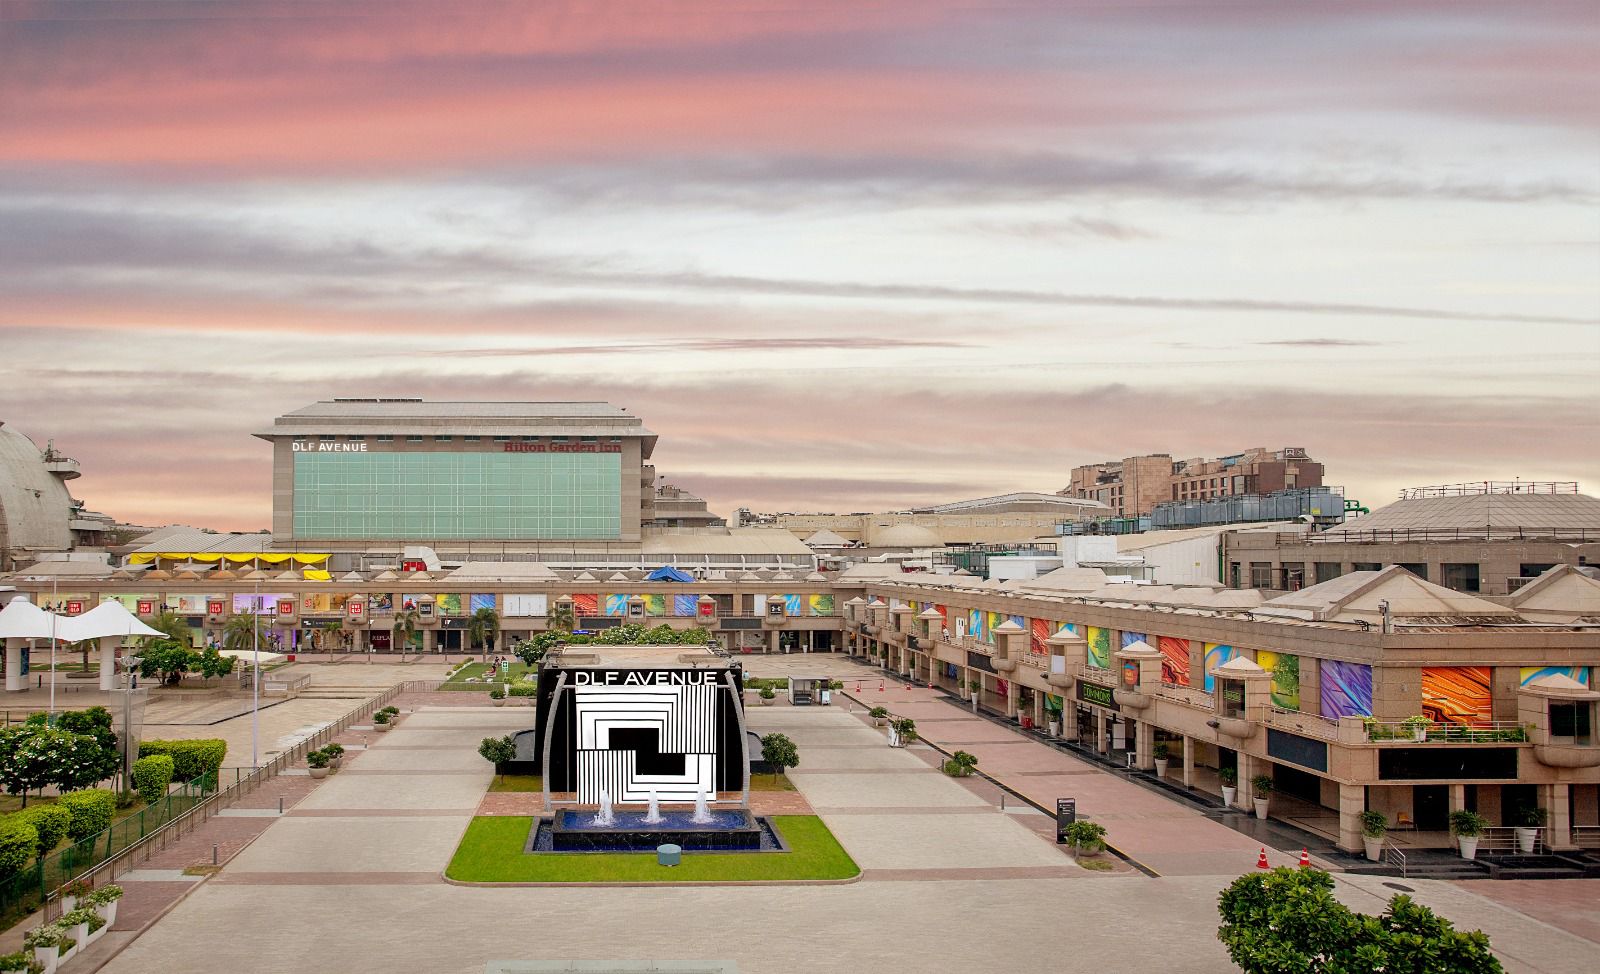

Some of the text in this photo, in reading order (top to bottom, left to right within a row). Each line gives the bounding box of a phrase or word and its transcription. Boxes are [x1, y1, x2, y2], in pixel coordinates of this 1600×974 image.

[292, 442, 368, 452] DLF AVENUE
[504, 442, 621, 453] Hilton Garden Inn
[575, 671, 717, 686] DLF AVENUE
